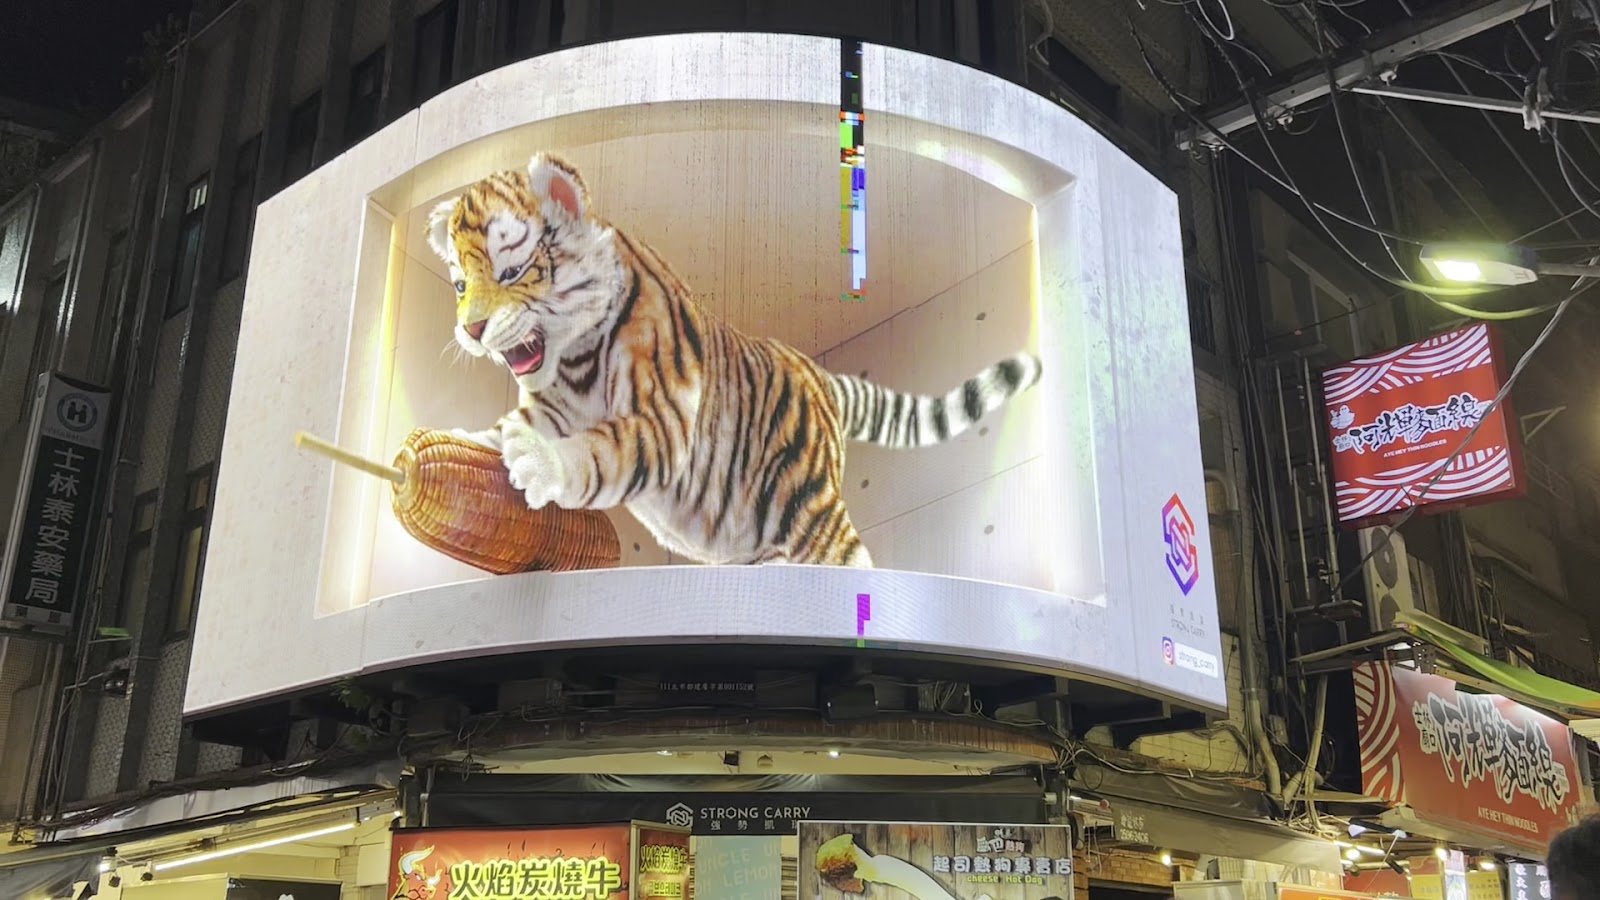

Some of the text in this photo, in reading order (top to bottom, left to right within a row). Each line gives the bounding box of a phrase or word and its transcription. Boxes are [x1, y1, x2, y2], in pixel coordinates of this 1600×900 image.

[1420, 439, 1447, 450] NOODLES
[25, 447, 84, 605] 士林泰安藥局
[700, 806, 811, 819] STRONG CARRY
[1478, 806, 1489, 820] AYE
[1489, 809, 1501, 823] HEY
[1514, 817, 1539, 834] NOODLES
[933, 855, 1072, 875] 起司熱狗專賣店
[452, 859, 620, 899] 火焰炭燒牛
[967, 874, 1043, 886] cheese Hot Dog
